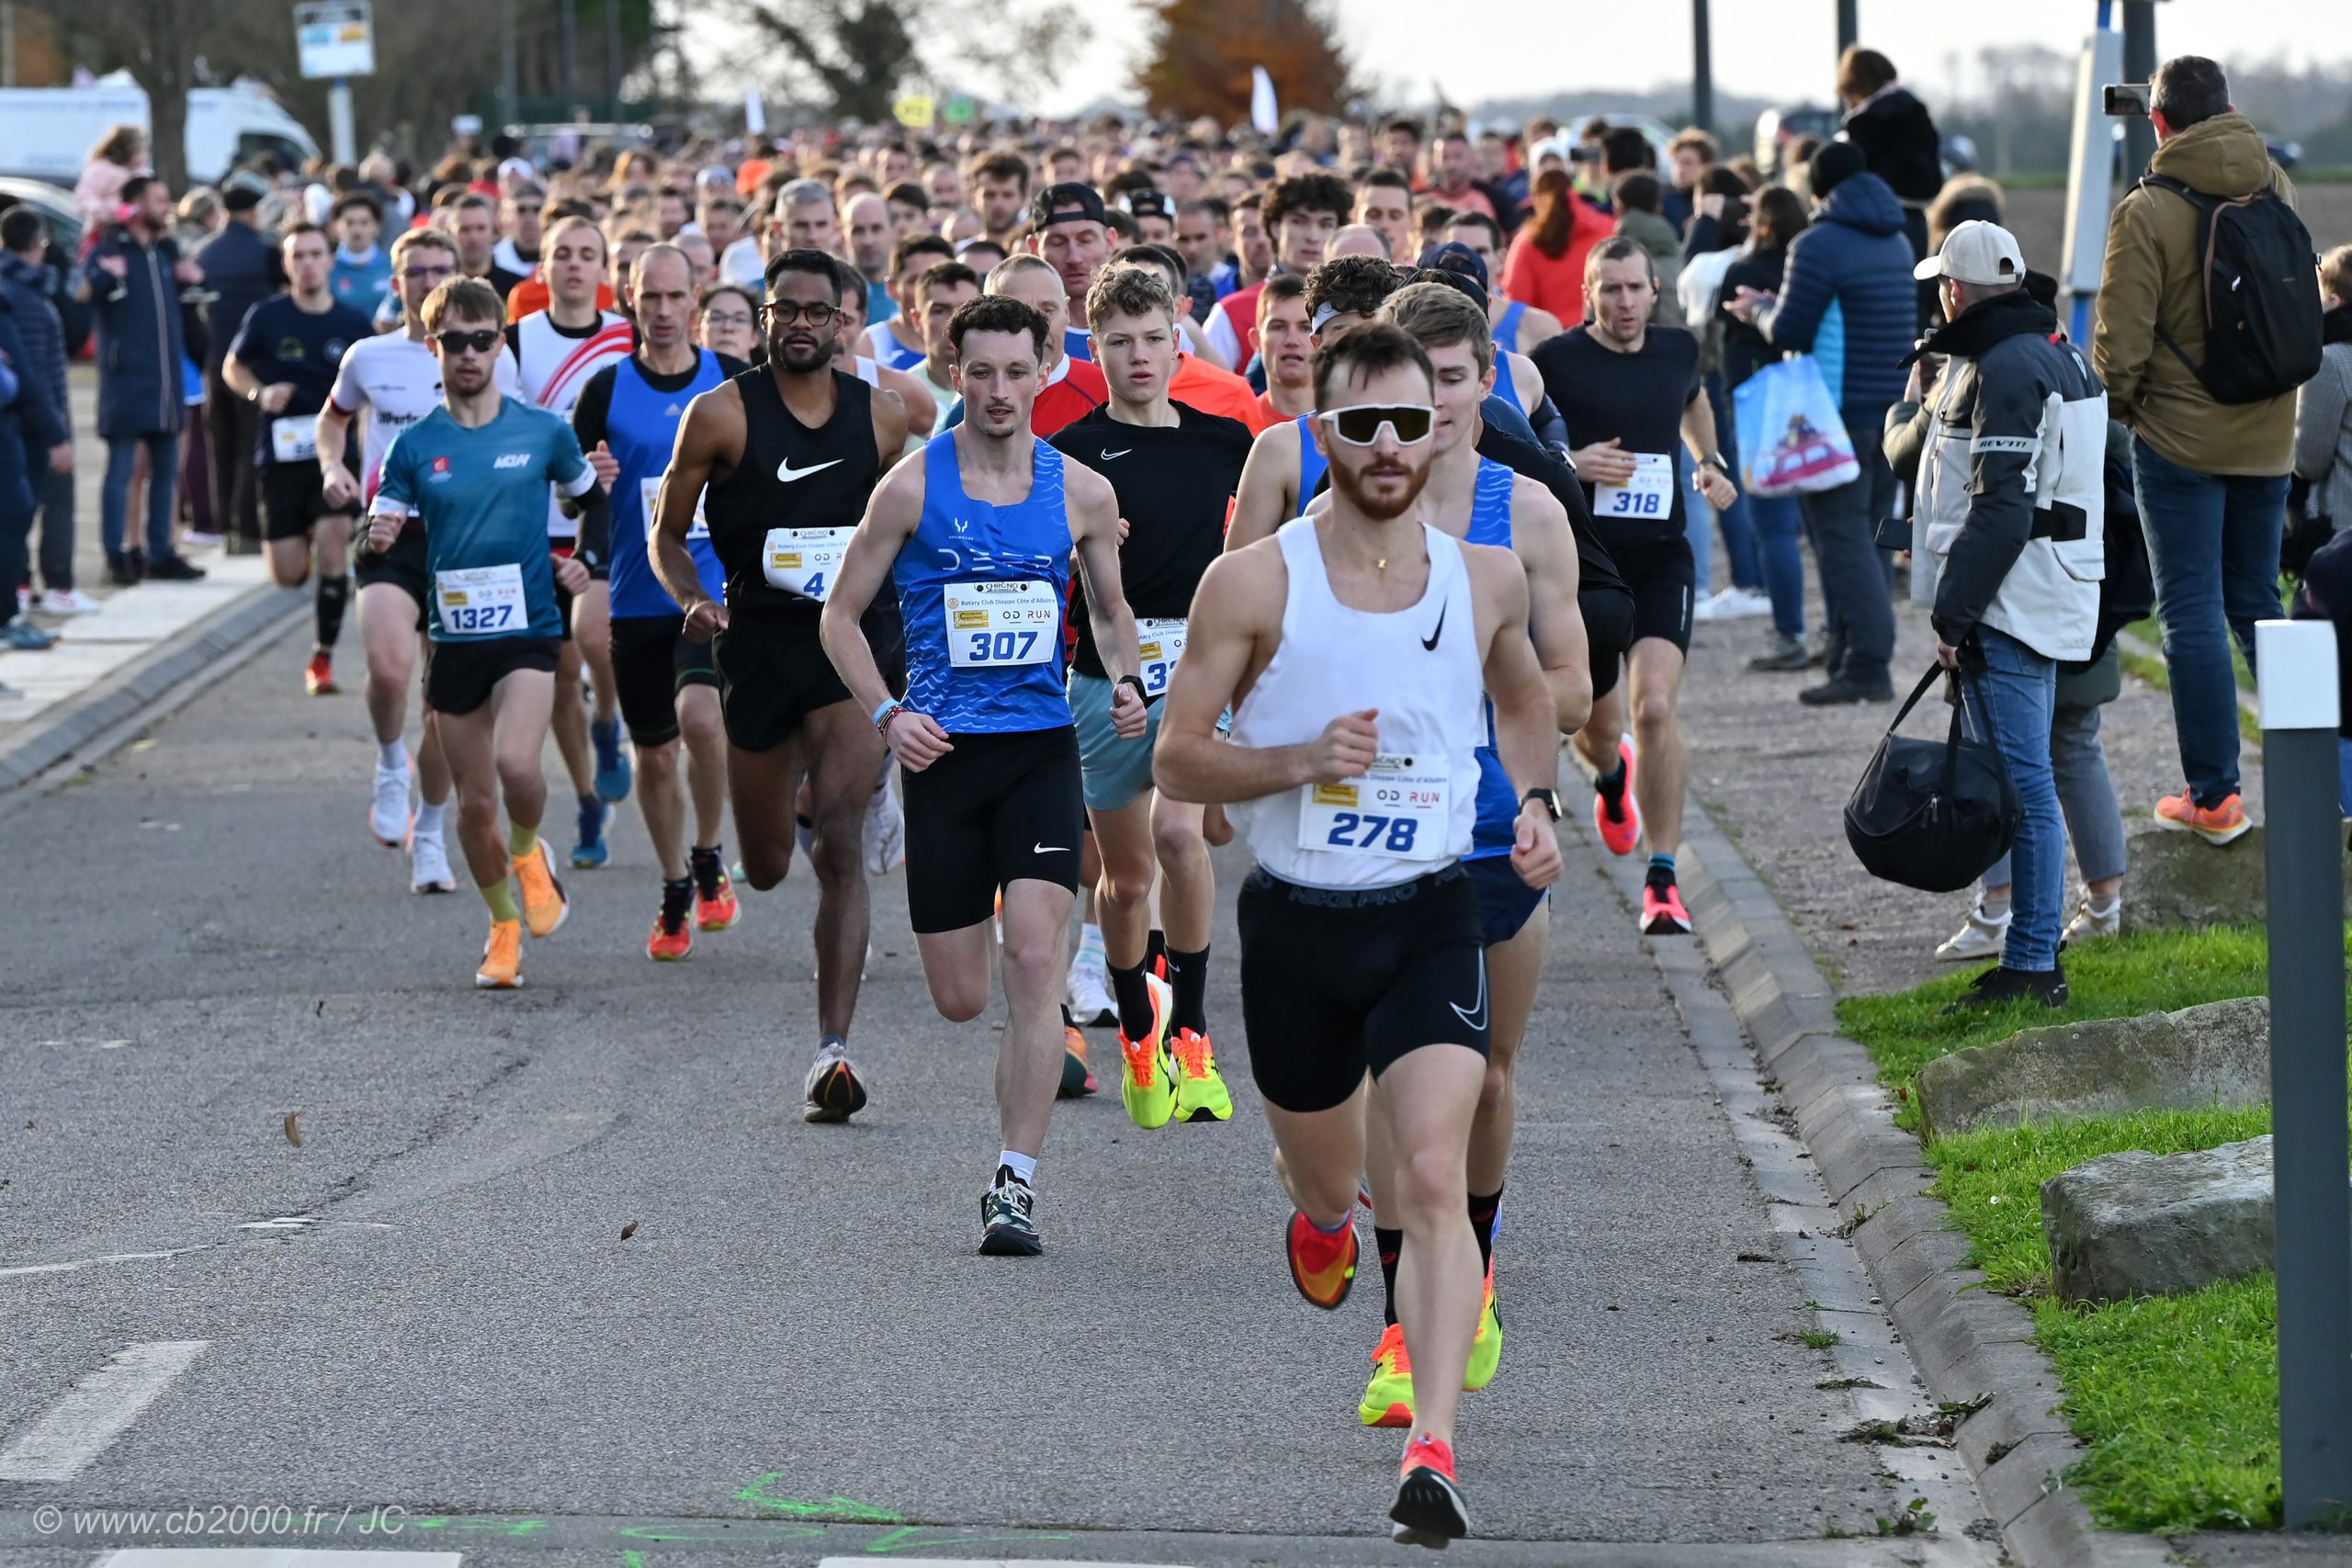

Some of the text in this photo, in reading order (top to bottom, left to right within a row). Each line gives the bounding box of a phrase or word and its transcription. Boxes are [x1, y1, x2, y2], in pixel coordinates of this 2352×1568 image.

[1613, 491, 1660, 513] 318
[803, 572, 824, 597] 4
[985, 581, 1019, 589] CHRONO
[995, 598, 1015, 606] Dieppe
[450, 604, 514, 630] 1327
[1002, 610, 1051, 619] OD RUN
[969, 631, 1038, 661] 307
[1377, 790, 1441, 802] OD RUN
[1328, 812, 1418, 852] 278
[1288, 882, 1419, 908] NIKE PRO
